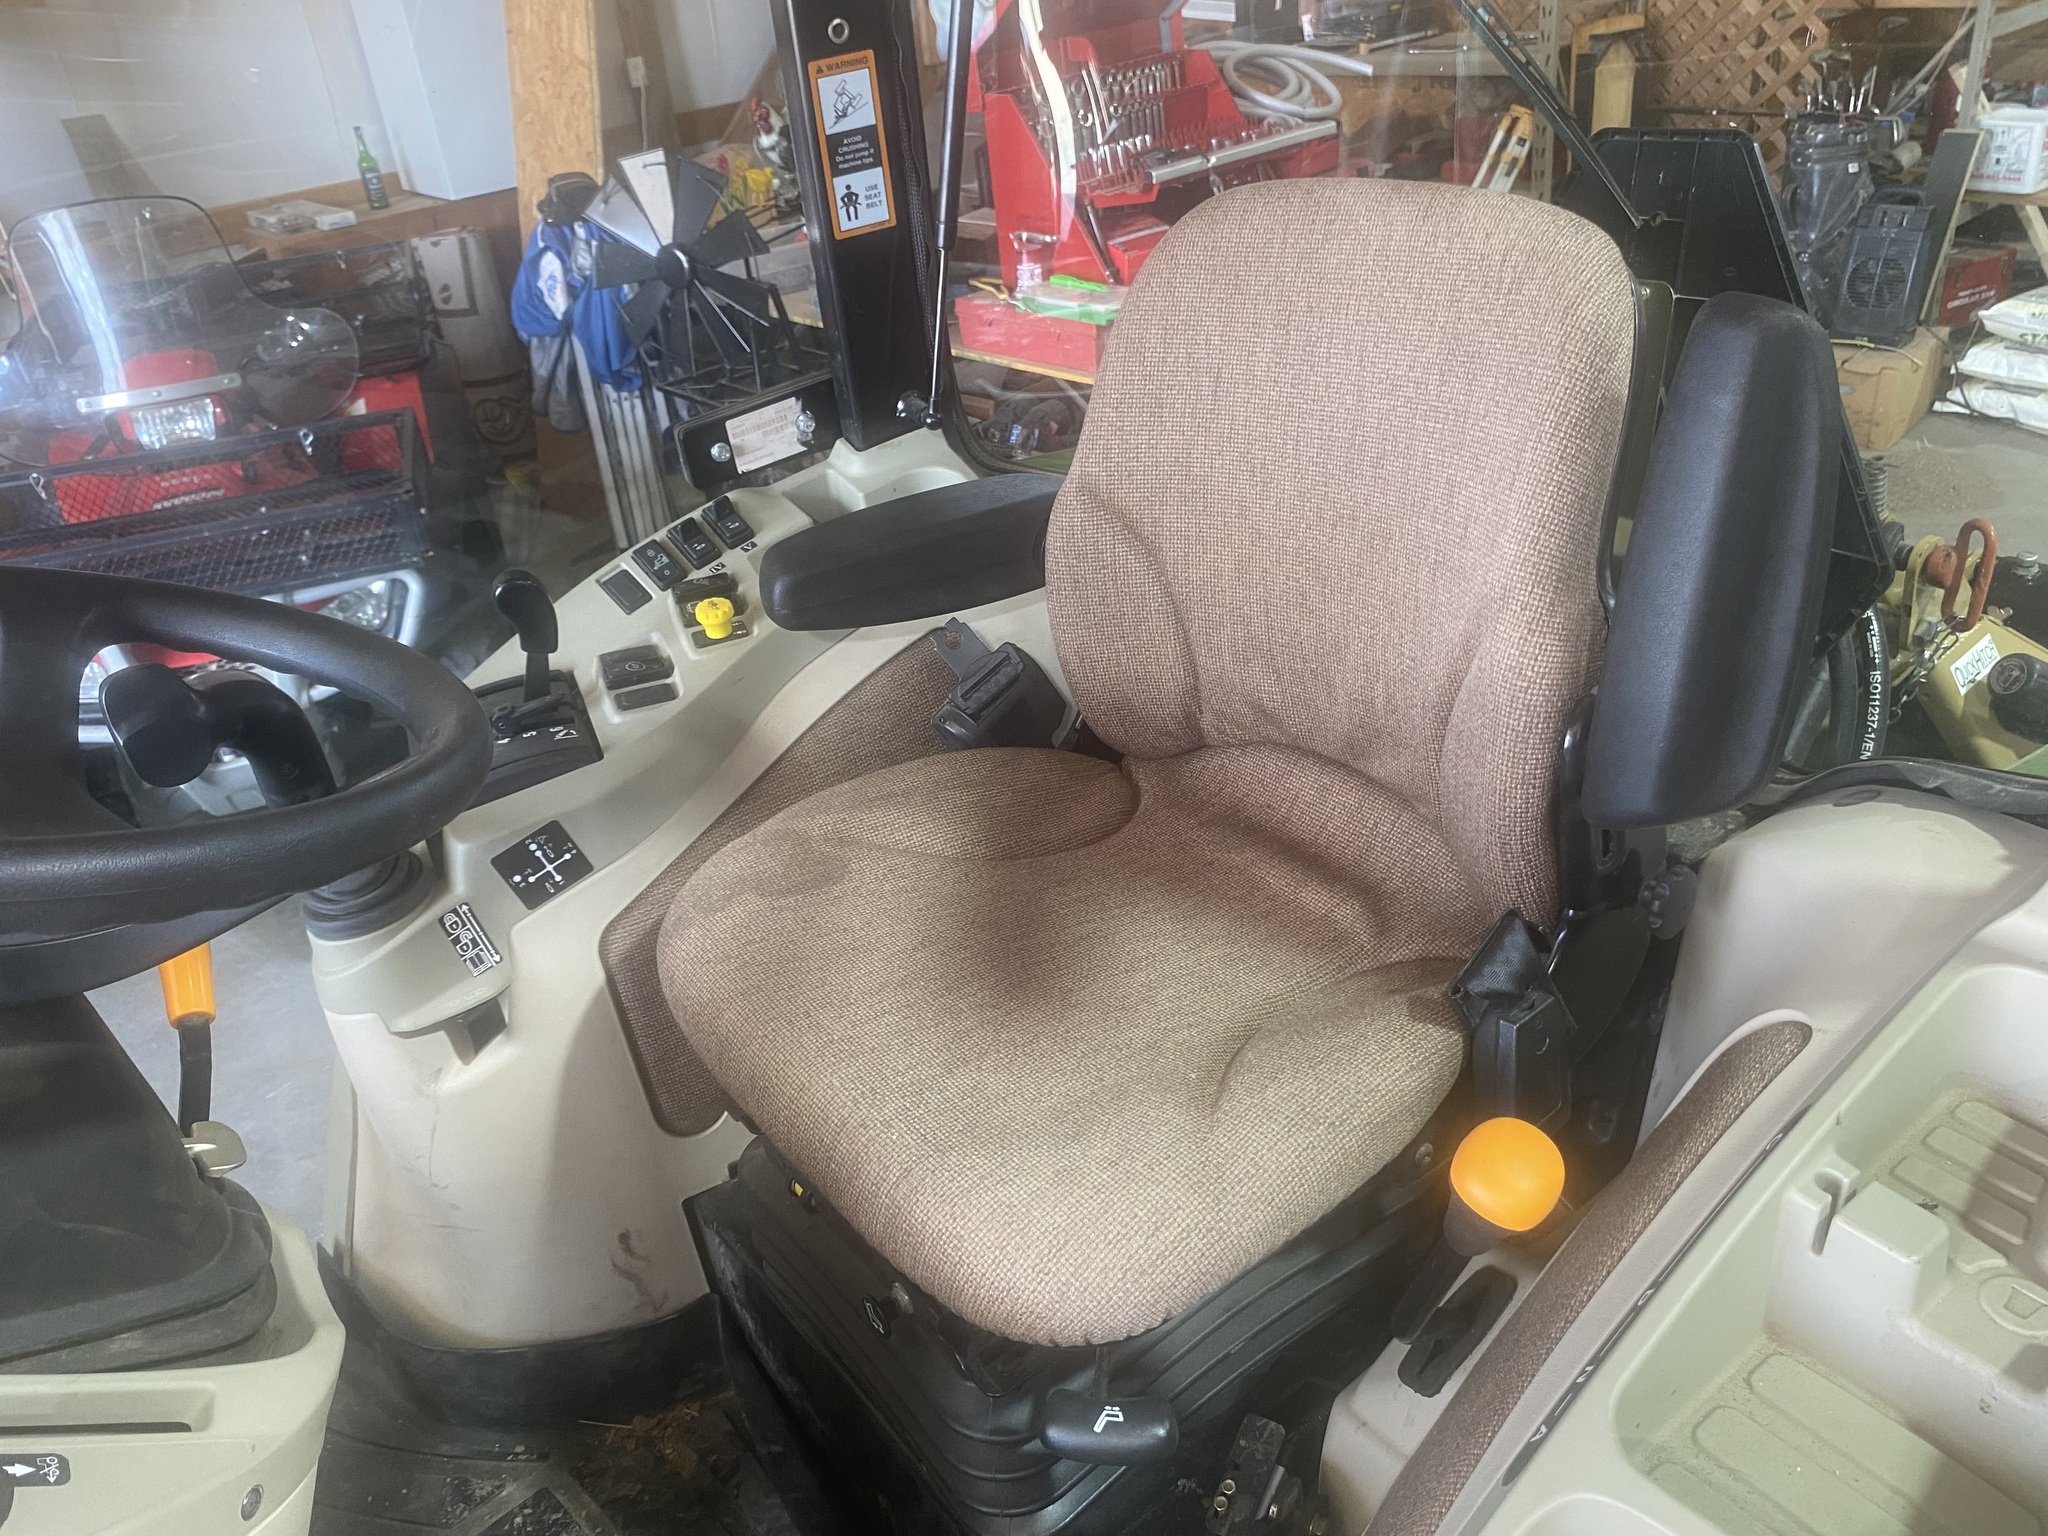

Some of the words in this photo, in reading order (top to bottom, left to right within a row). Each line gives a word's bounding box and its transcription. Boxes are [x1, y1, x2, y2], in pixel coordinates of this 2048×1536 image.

[825, 56, 869, 71] WARNING
[843, 135, 863, 145] AVOID
[838, 141, 869, 154] CRUSHING
[845, 152, 855, 160] not
[855, 150, 869, 159] jump
[838, 160, 862, 169] machine
[865, 184, 879, 193] USE
[865, 192, 882, 201] SEAT
[866, 200, 883, 209] BELT
[743, 542, 753, 550] V
[710, 562, 723, 573] IV
[1859, 670, 1882, 760] ISO11237-1/EN
